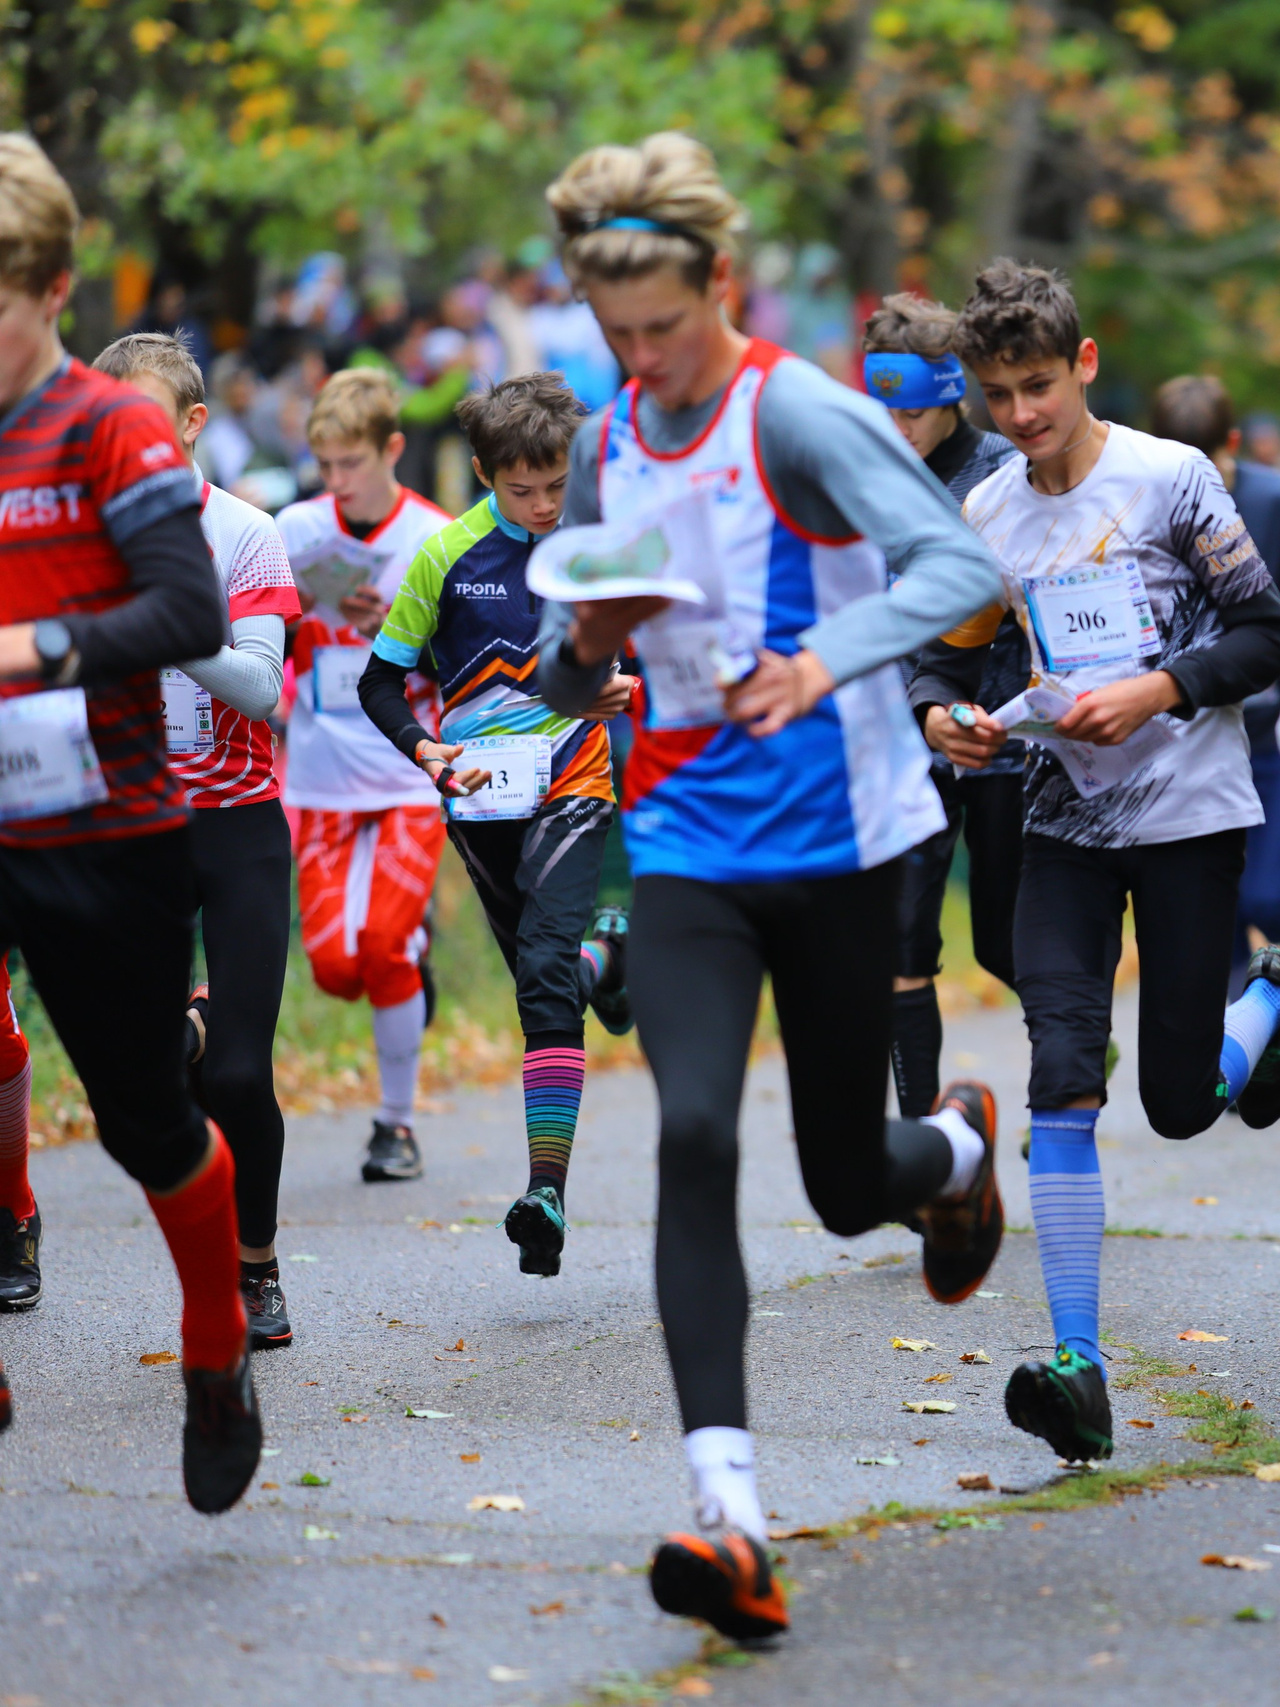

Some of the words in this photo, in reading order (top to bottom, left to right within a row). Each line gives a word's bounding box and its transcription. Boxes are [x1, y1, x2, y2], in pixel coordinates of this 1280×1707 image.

[454, 583, 508, 596] ТРОПА
[1065, 607, 1106, 633] 206
[480, 769, 509, 790] 13
